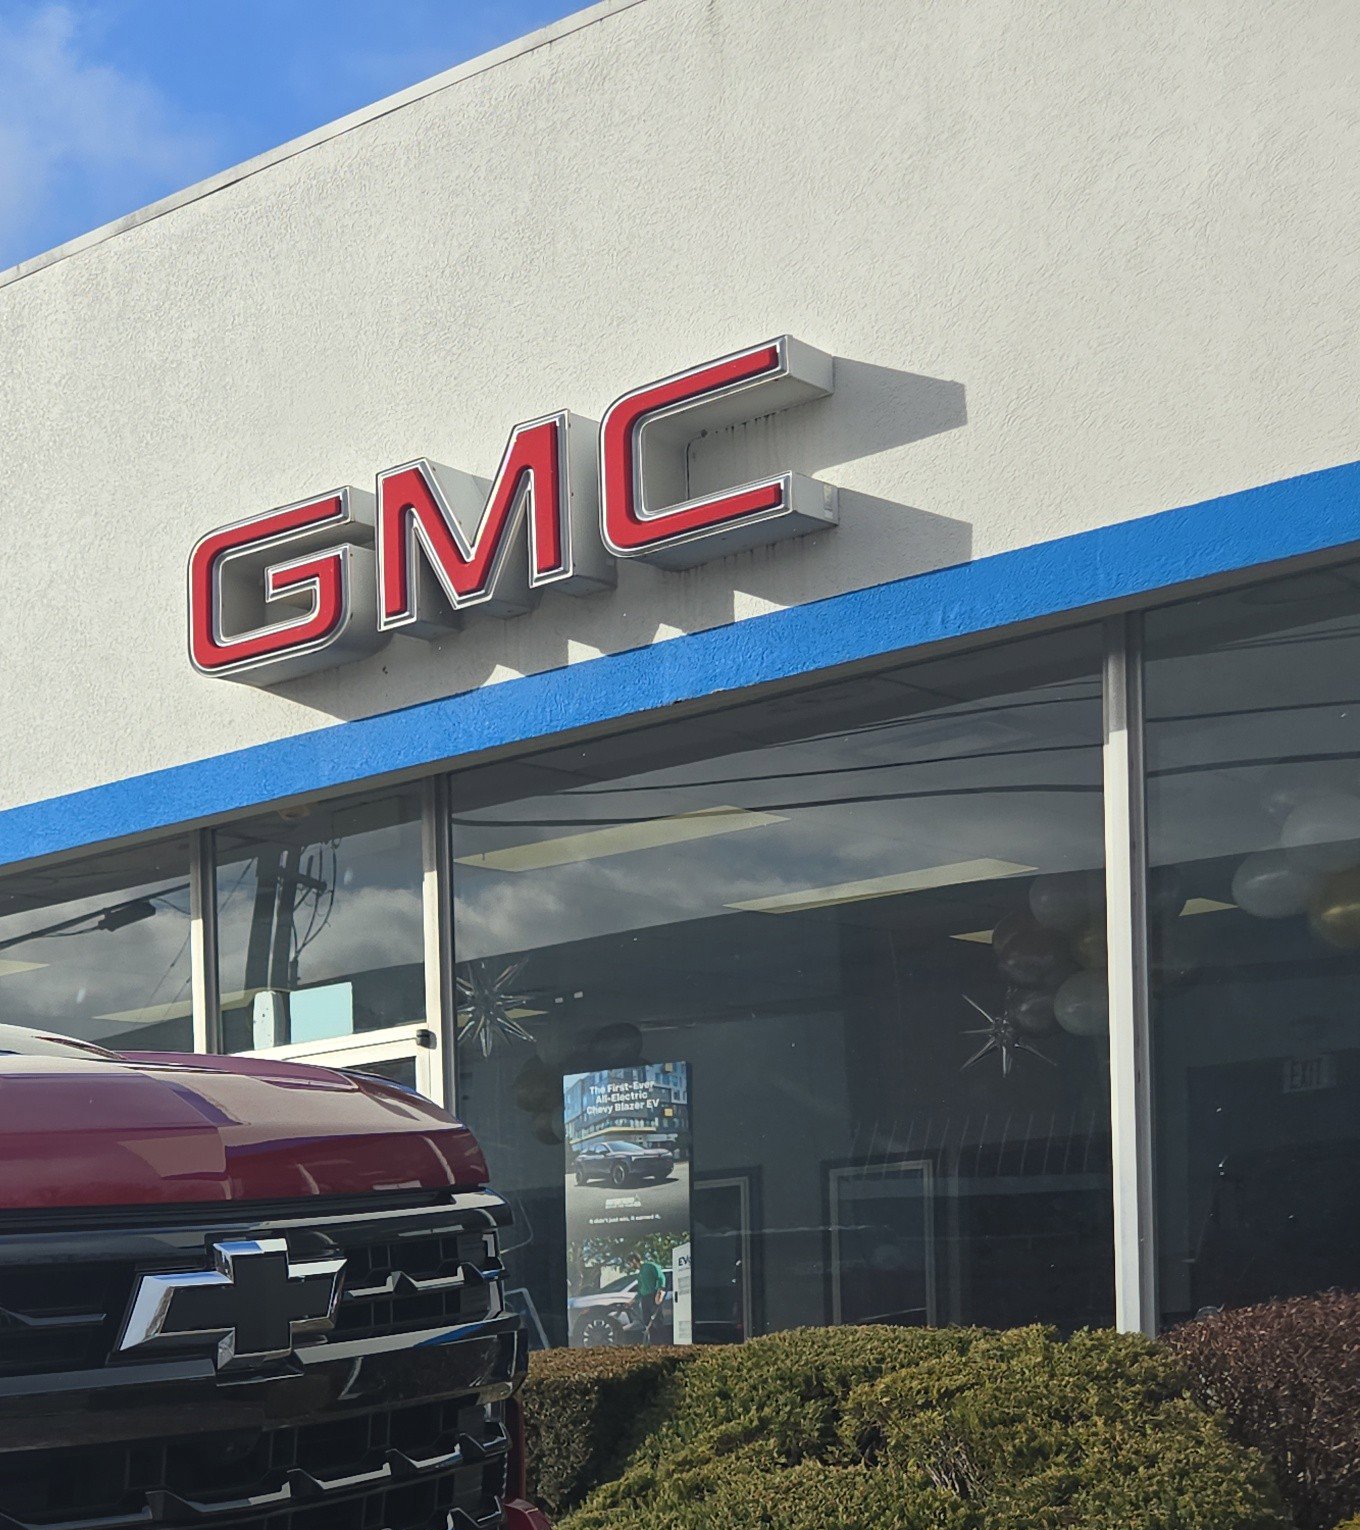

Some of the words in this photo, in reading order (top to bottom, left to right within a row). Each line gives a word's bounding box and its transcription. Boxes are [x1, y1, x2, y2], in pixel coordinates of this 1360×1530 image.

[187, 334, 836, 684] GMC
[589, 1085, 606, 1095] The
[607, 1080, 655, 1093] First-Ever
[595, 1090, 648, 1104] All-Electric
[586, 1104, 613, 1115] Chevy
[614, 1101, 645, 1112] Blazer
[646, 1098, 660, 1109] EV
